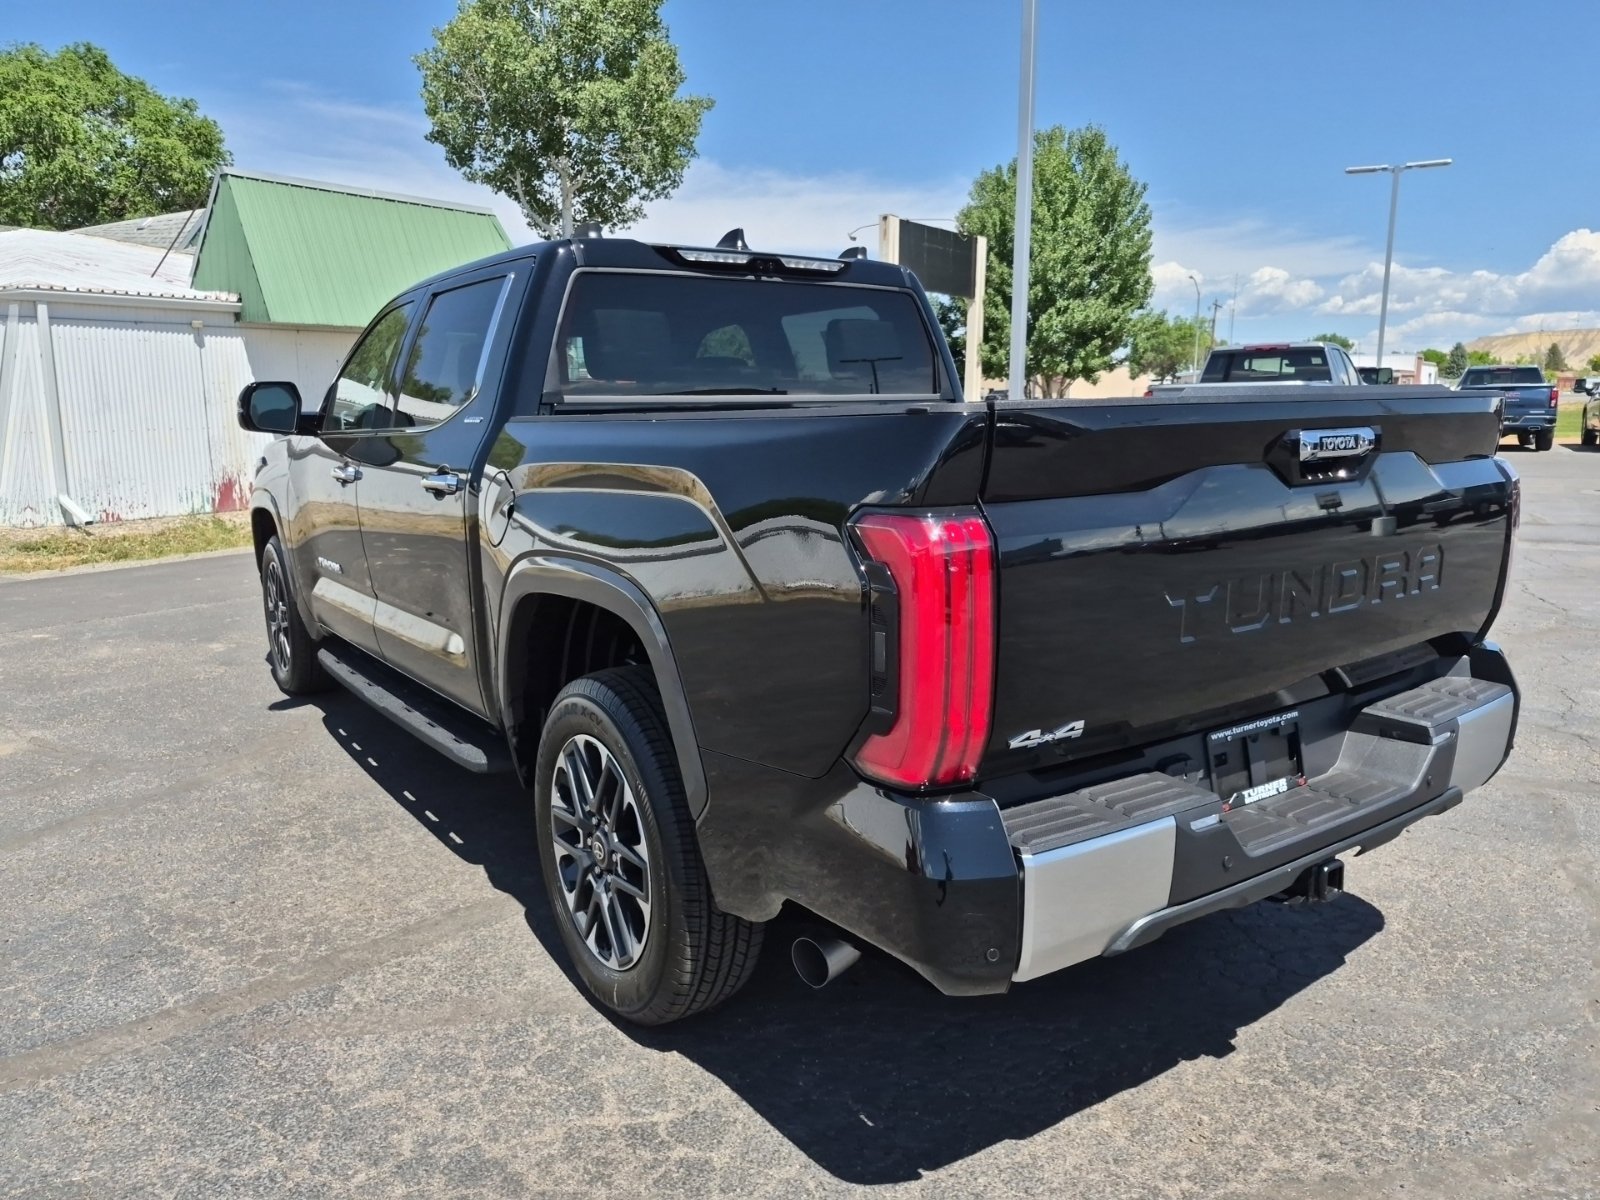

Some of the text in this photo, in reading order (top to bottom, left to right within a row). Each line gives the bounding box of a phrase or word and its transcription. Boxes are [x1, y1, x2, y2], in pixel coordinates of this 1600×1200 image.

[1322, 437, 1356, 450] TOYOTA
[1164, 544, 1444, 643] TUNDRA
[1008, 720, 1085, 749] 4x4
[1211, 711, 1298, 740] www.turnertoyota.com
[1242, 777, 1287, 798] TURNER
